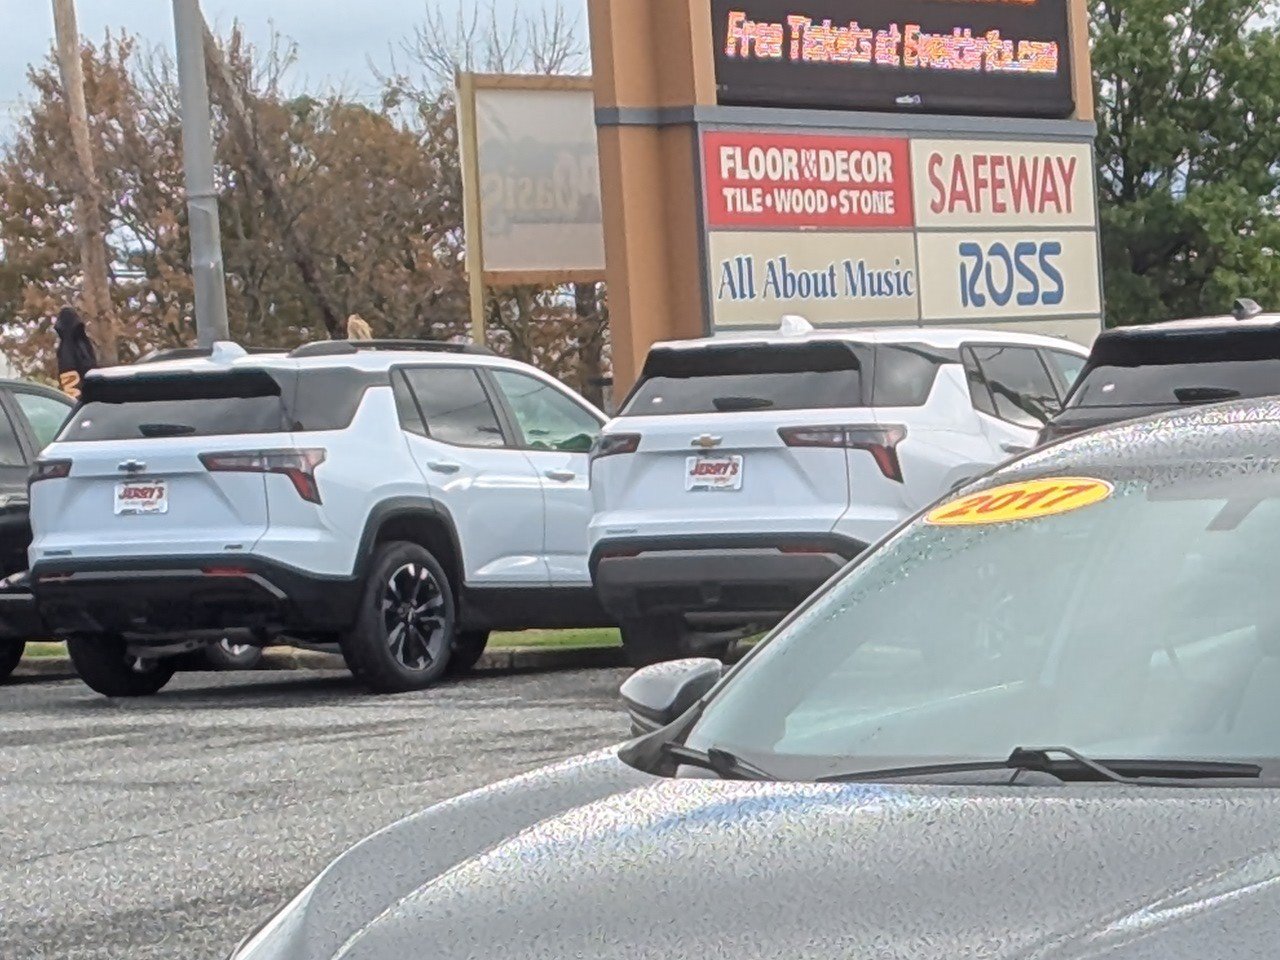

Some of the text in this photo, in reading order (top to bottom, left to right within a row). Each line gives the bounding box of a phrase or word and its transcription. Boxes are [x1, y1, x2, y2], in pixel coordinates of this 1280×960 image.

[726, 11, 783, 58] Free
[787, 15, 873, 62] Tickets
[875, 23, 901, 66] at
[719, 145, 799, 180] FLOOR
[819, 149, 893, 183] DECOR
[927, 152, 1077, 214] SAFEWAY
[722, 187, 895, 215] TILE WOOD STONE
[718, 256, 915, 300] All About Music
[958, 241, 1065, 308] ROSS
[936, 484, 1098, 520] 2017
